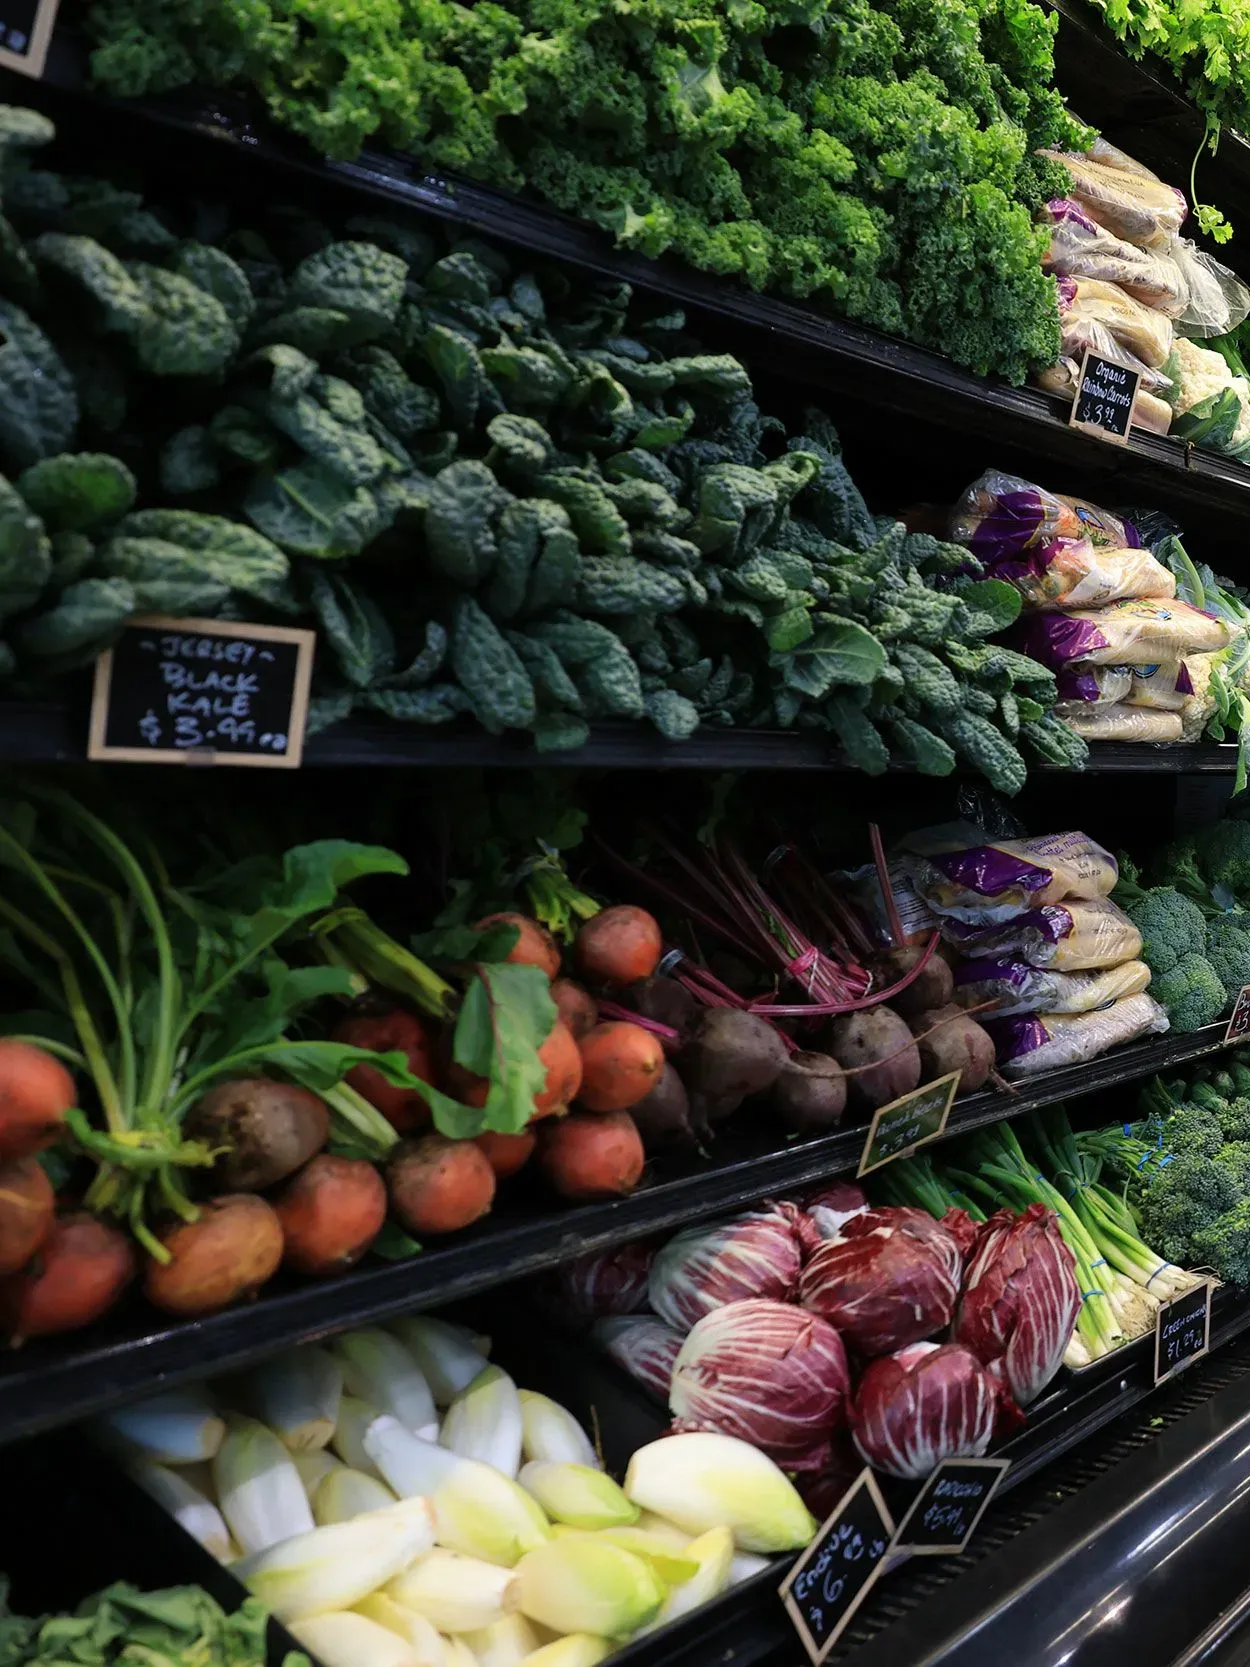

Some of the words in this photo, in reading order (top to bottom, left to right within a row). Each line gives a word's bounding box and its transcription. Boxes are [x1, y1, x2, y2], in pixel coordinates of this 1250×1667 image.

[1095, 361, 1127, 385] Organic
[1106, 385, 1131, 408] Carrots
[160, 635, 256, 666] JERSEY
[159, 661, 260, 693] BLACK
[167, 691, 250, 718] KALE
[793, 1523, 854, 1600] Endive
